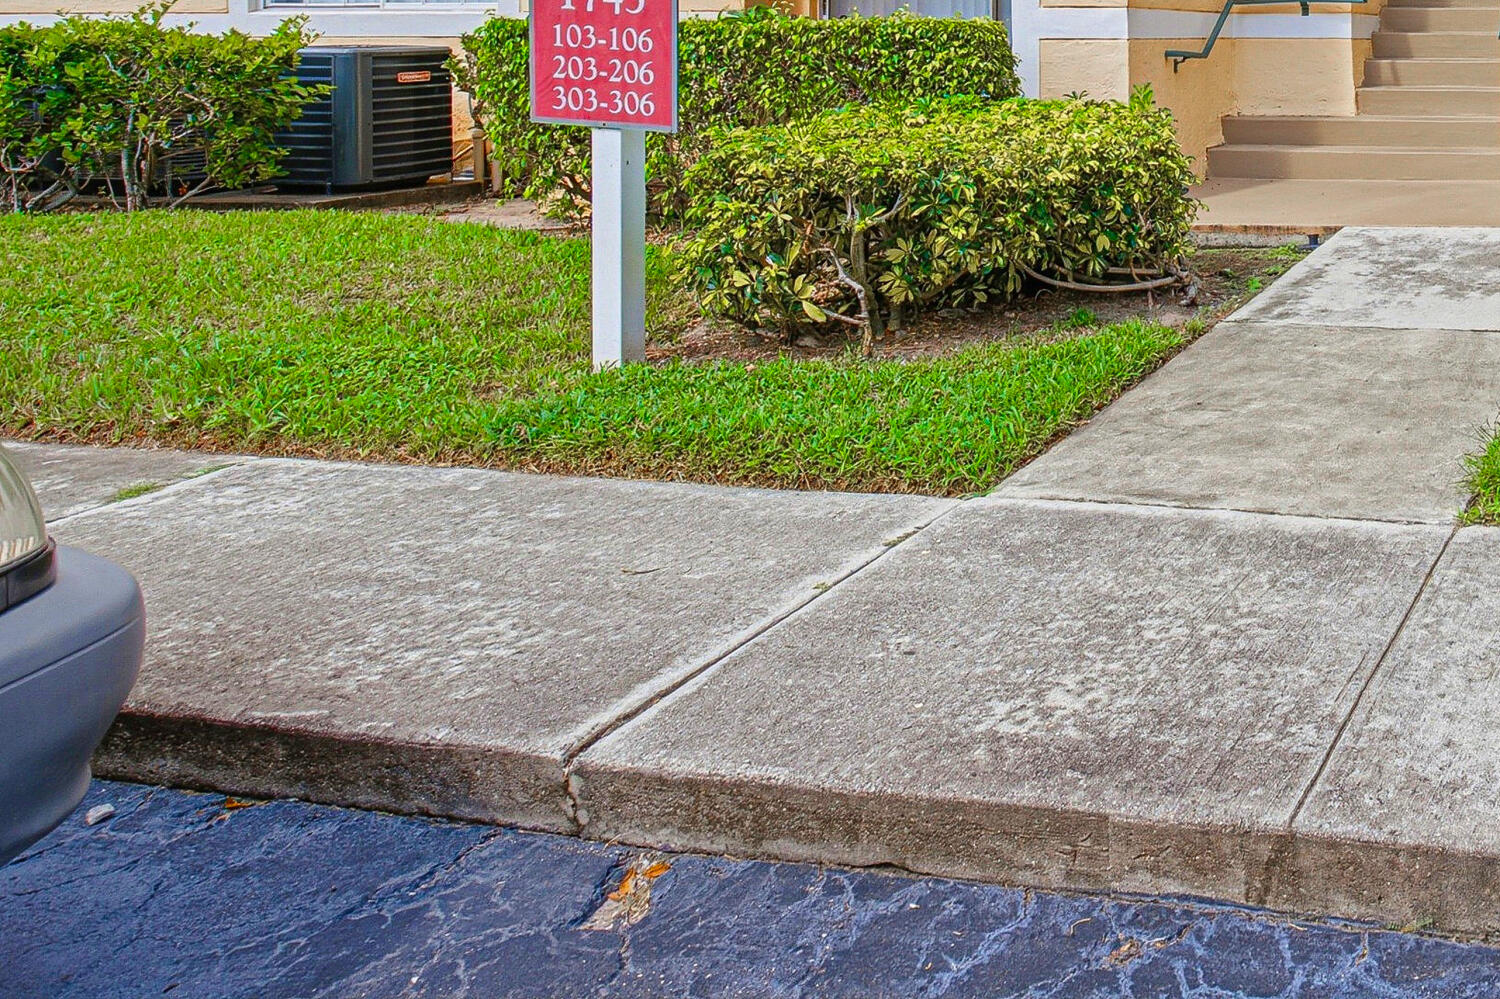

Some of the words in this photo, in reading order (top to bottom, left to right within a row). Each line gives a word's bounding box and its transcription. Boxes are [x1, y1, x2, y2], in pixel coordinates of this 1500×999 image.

[552, 23, 654, 54] 103-106
[552, 55, 655, 85] 203-206
[552, 86, 656, 117] 303-306
